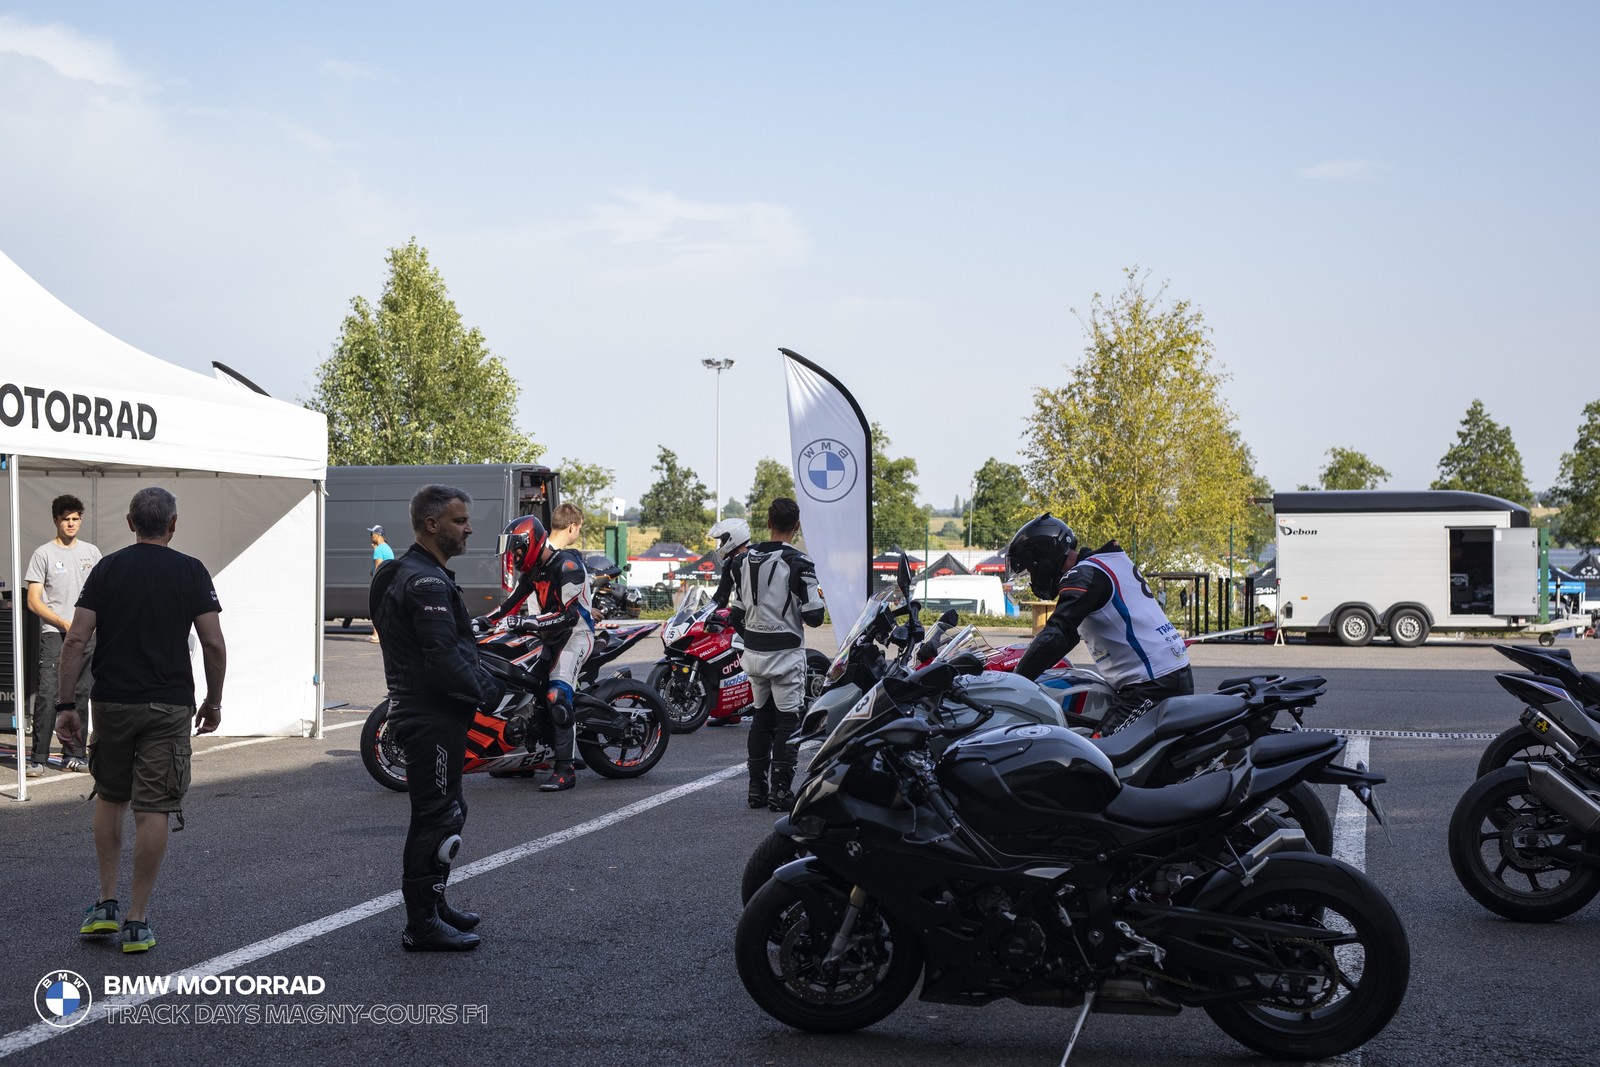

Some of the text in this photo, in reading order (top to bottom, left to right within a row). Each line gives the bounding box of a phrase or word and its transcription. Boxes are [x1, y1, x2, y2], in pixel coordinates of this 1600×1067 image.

[0, 382, 158, 441] OTORRAD
[1279, 525, 1318, 536] Debon
[1155, 622, 1174, 635] TRAC
[436, 743, 448, 796] RST
